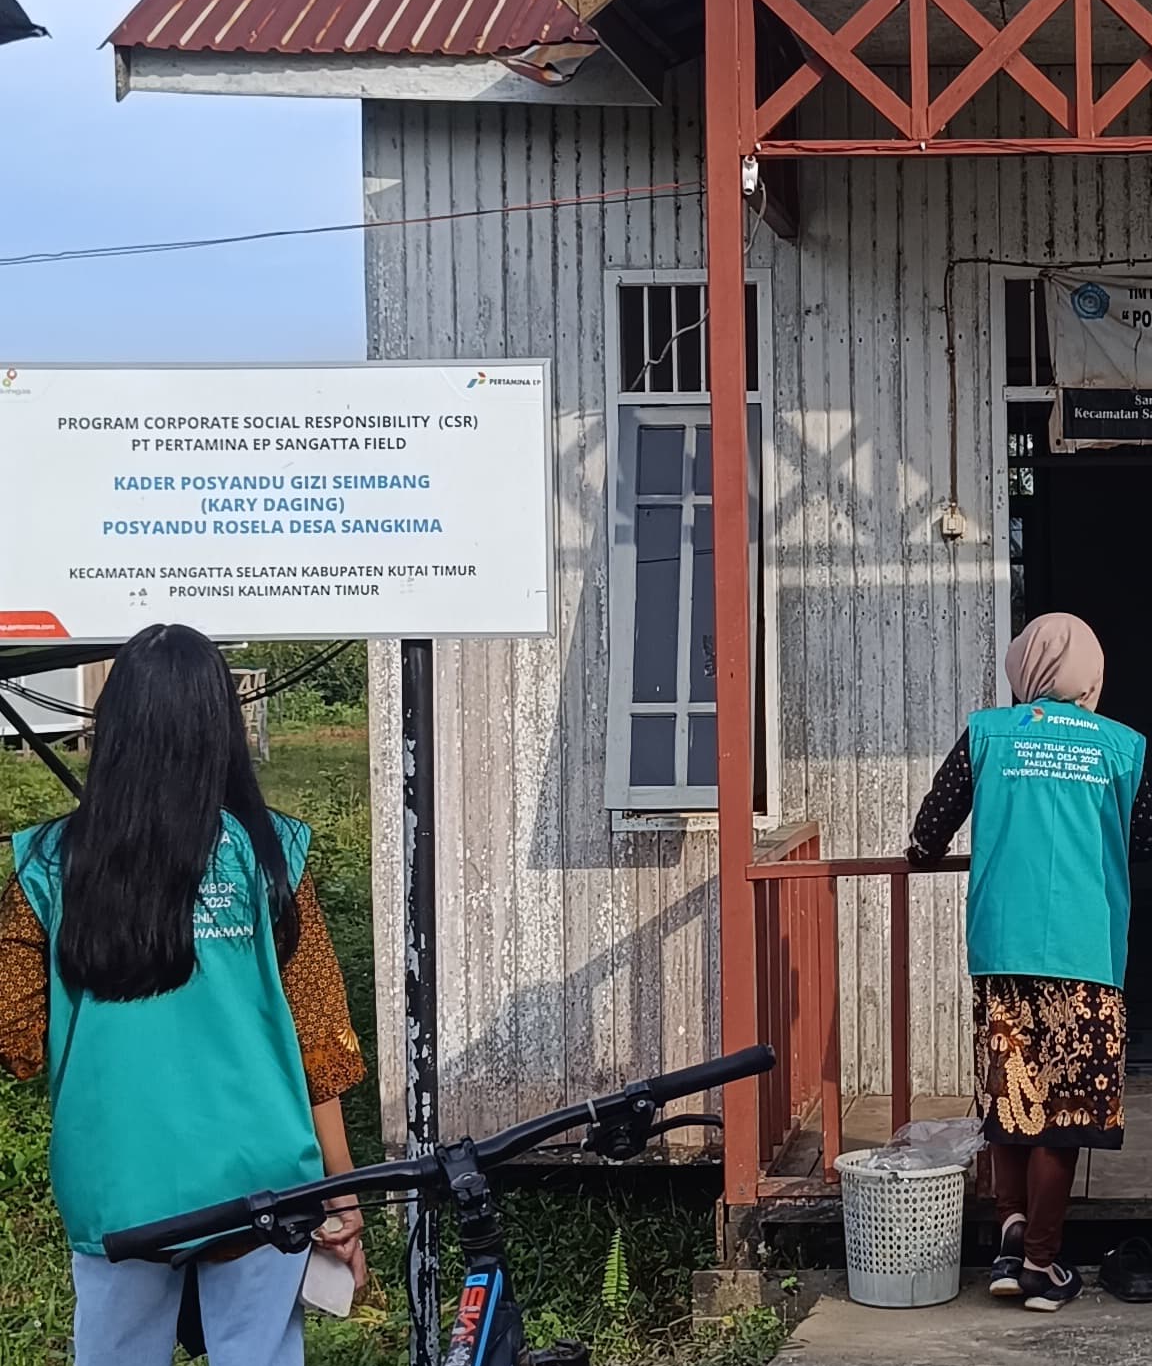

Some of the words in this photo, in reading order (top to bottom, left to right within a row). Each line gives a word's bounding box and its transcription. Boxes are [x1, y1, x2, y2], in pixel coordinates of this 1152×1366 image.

[1128, 288, 1147, 300] TIM
[1074, 408, 1139, 419] Kecamatan
[57, 417, 139, 430] PROGRAM
[144, 416, 239, 429] CORPORATE
[243, 416, 300, 429] SOCIAL
[304, 415, 431, 428] RESPONSIBILITY
[438, 415, 478, 430] (CSR)
[131, 438, 150, 451] PT
[155, 438, 249, 451] PERTAMINA
[253, 438, 271, 450] EP
[275, 437, 360, 450] SANGATTA
[364, 437, 406, 450] FIELD
[114, 476, 175, 490] KADER
[181, 476, 284, 490] POSYANDU
[291, 475, 327, 489] GIZI
[332, 475, 430, 489] SEIMBANG
[201, 497, 258, 515] (KARY
[264, 496, 345, 514] DAGING)
[103, 520, 207, 535] POSYANDU
[213, 519, 284, 534] ROSELA
[290, 519, 336, 534] DESA
[341, 518, 443, 533] SANGKIMA
[69, 567, 156, 579] KECAMATAN
[160, 567, 233, 578] SANGATTA
[236, 566, 297, 578] SELATAN
[301, 565, 383, 577] KABUPATEN
[388, 565, 428, 577] KUTAI
[432, 565, 476, 576] TIMUR
[169, 586, 234, 597] PROVINSI
[238, 585, 330, 597] KALIMANTAN
[334, 584, 380, 596] TIMUR
[1047, 715, 1100, 731] PERTAMINA
[1014, 741, 1040, 750] DUSUN
[1043, 742, 1066, 752] TELUK
[1068, 745, 1103, 757] LOMBOK
[1036, 751, 1054, 760] BINA
[1057, 753, 1078, 762] DESA
[1080, 755, 1099, 765] 2025
[1024, 759, 1062, 770] FAKULTAS
[1064, 762, 1090, 772] TEKNIK
[1002, 768, 1049, 778] UNIVERSITAS
[1051, 770, 1110, 785] MULAWARMAN
[197, 882, 237, 894] MBOK
[193, 924, 254, 939] WARMAN
